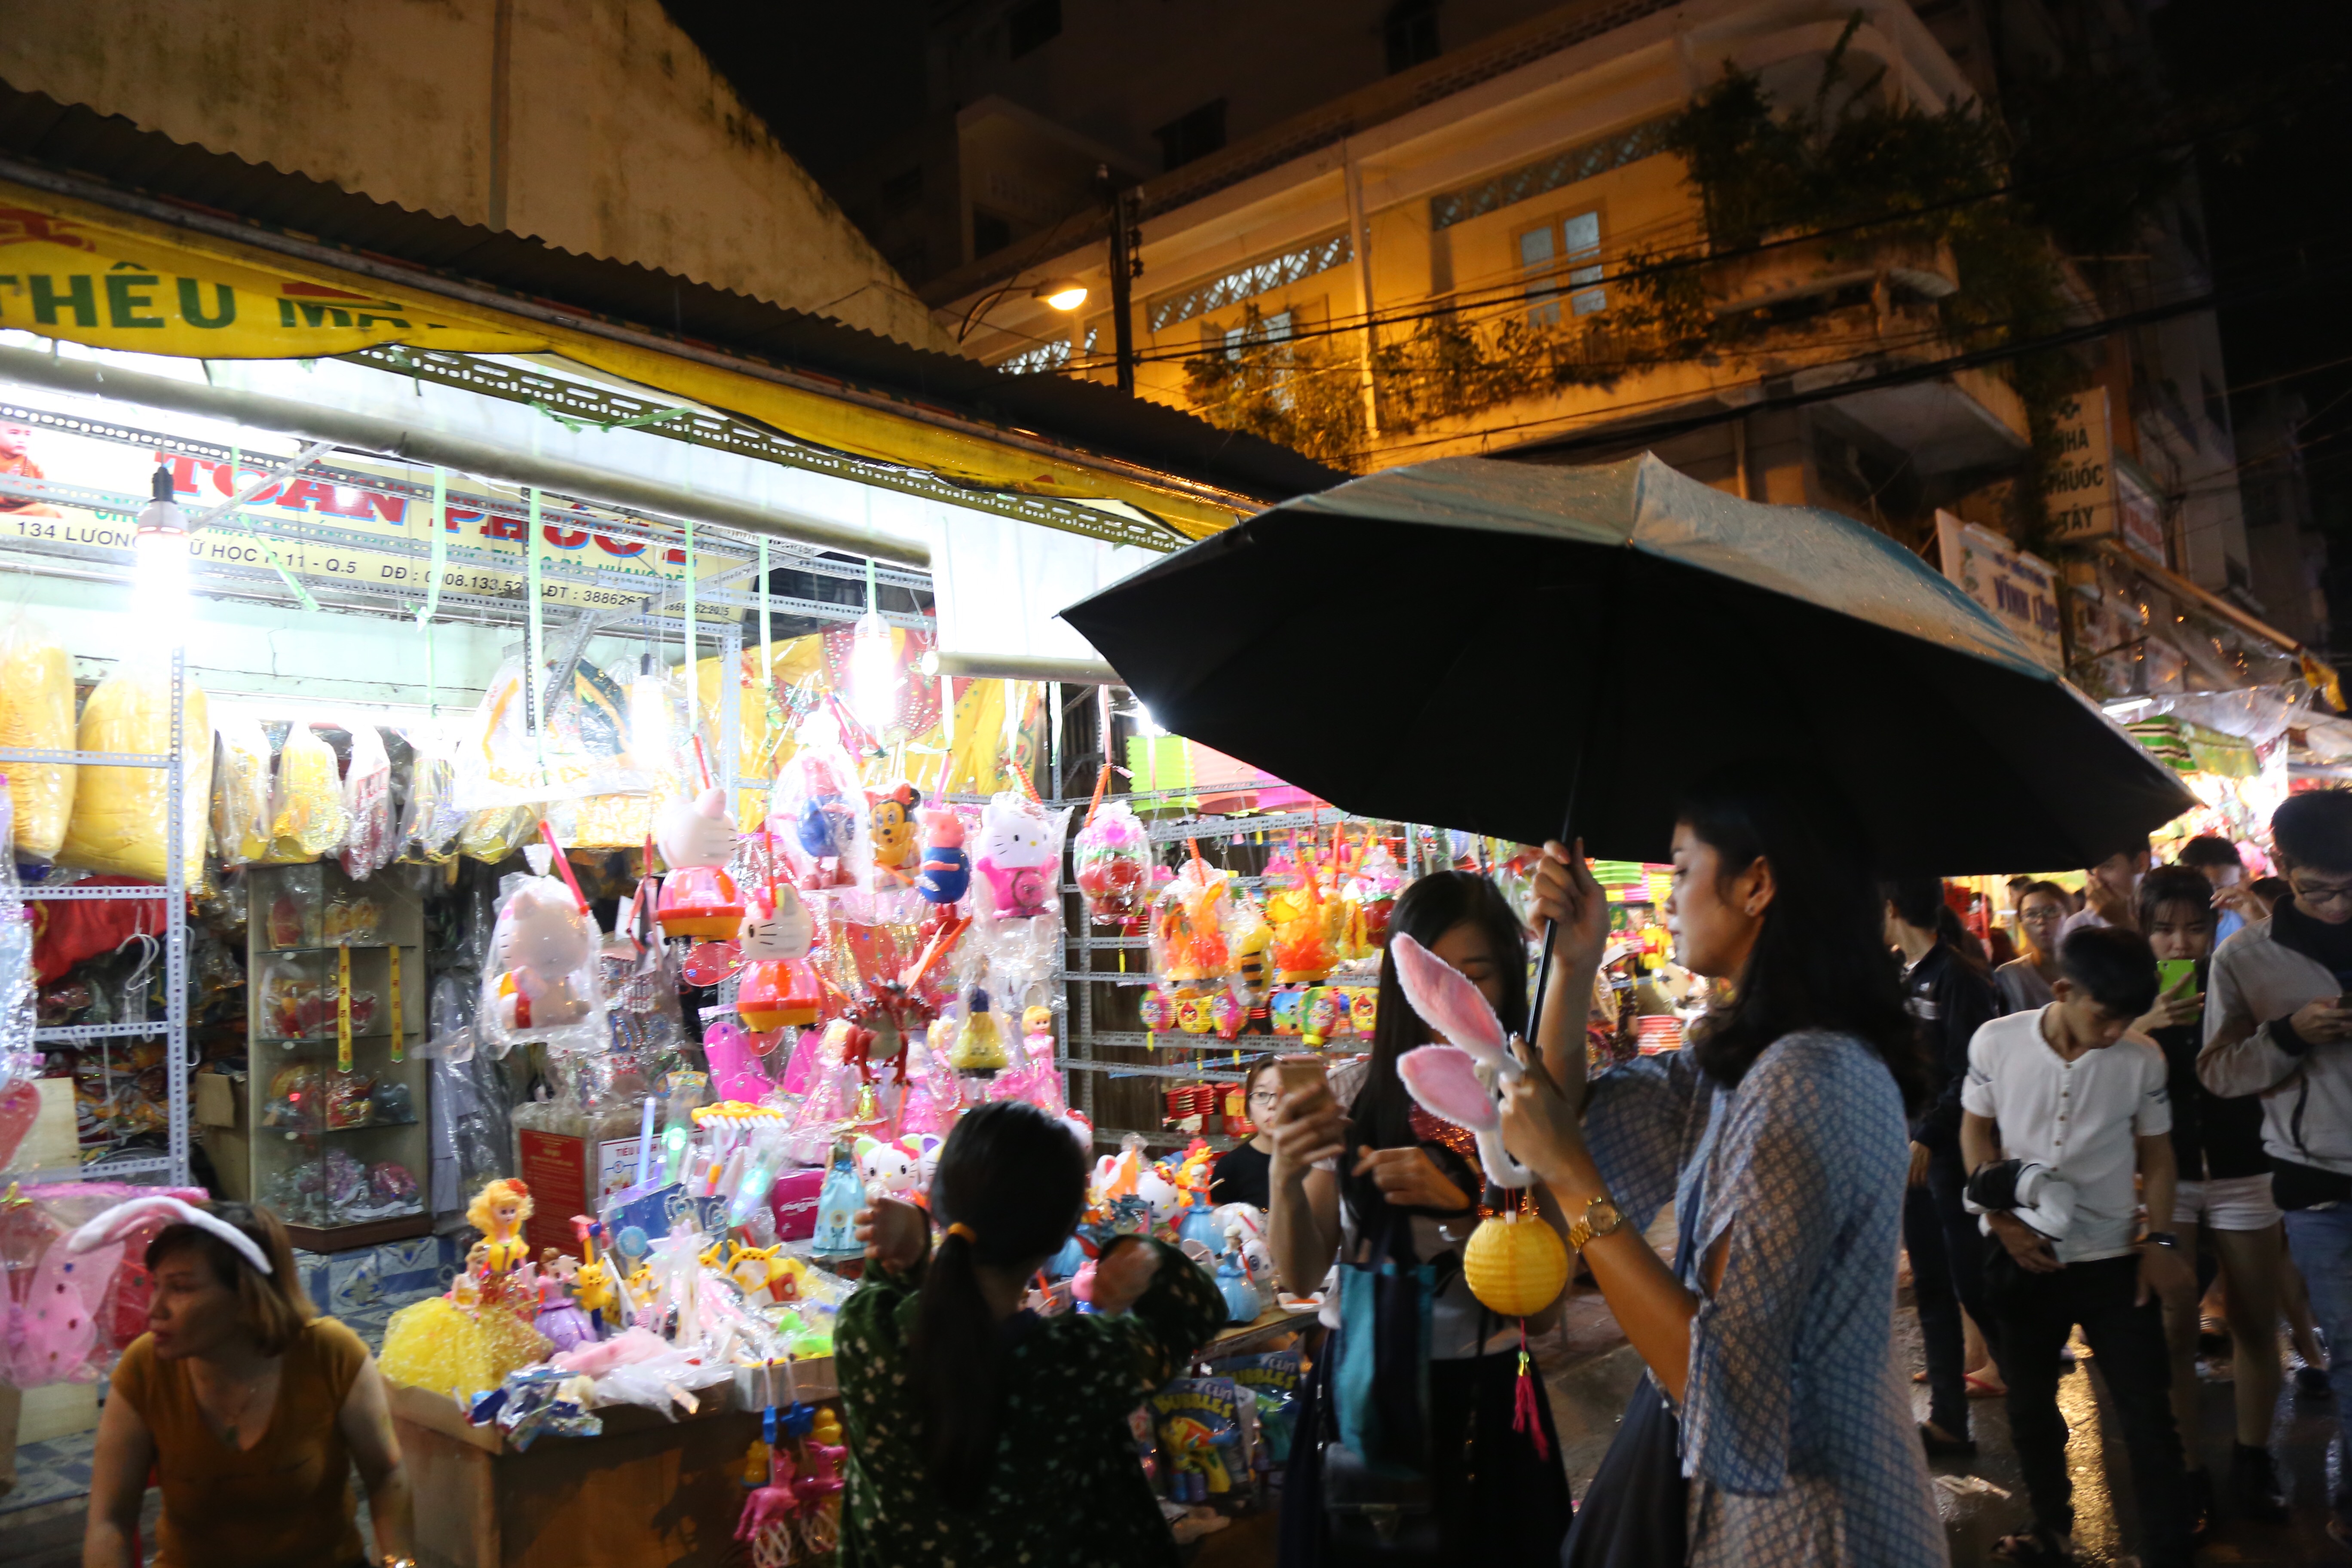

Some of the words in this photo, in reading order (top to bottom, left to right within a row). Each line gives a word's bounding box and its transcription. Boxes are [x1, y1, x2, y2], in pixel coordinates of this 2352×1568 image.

[18, 521, 56, 539] 134
[66, 526, 139, 549] LƯƠN
[211, 543, 257, 562] HỌC
[326, 558, 357, 573] Q.5
[381, 565, 407, 579] DĐ
